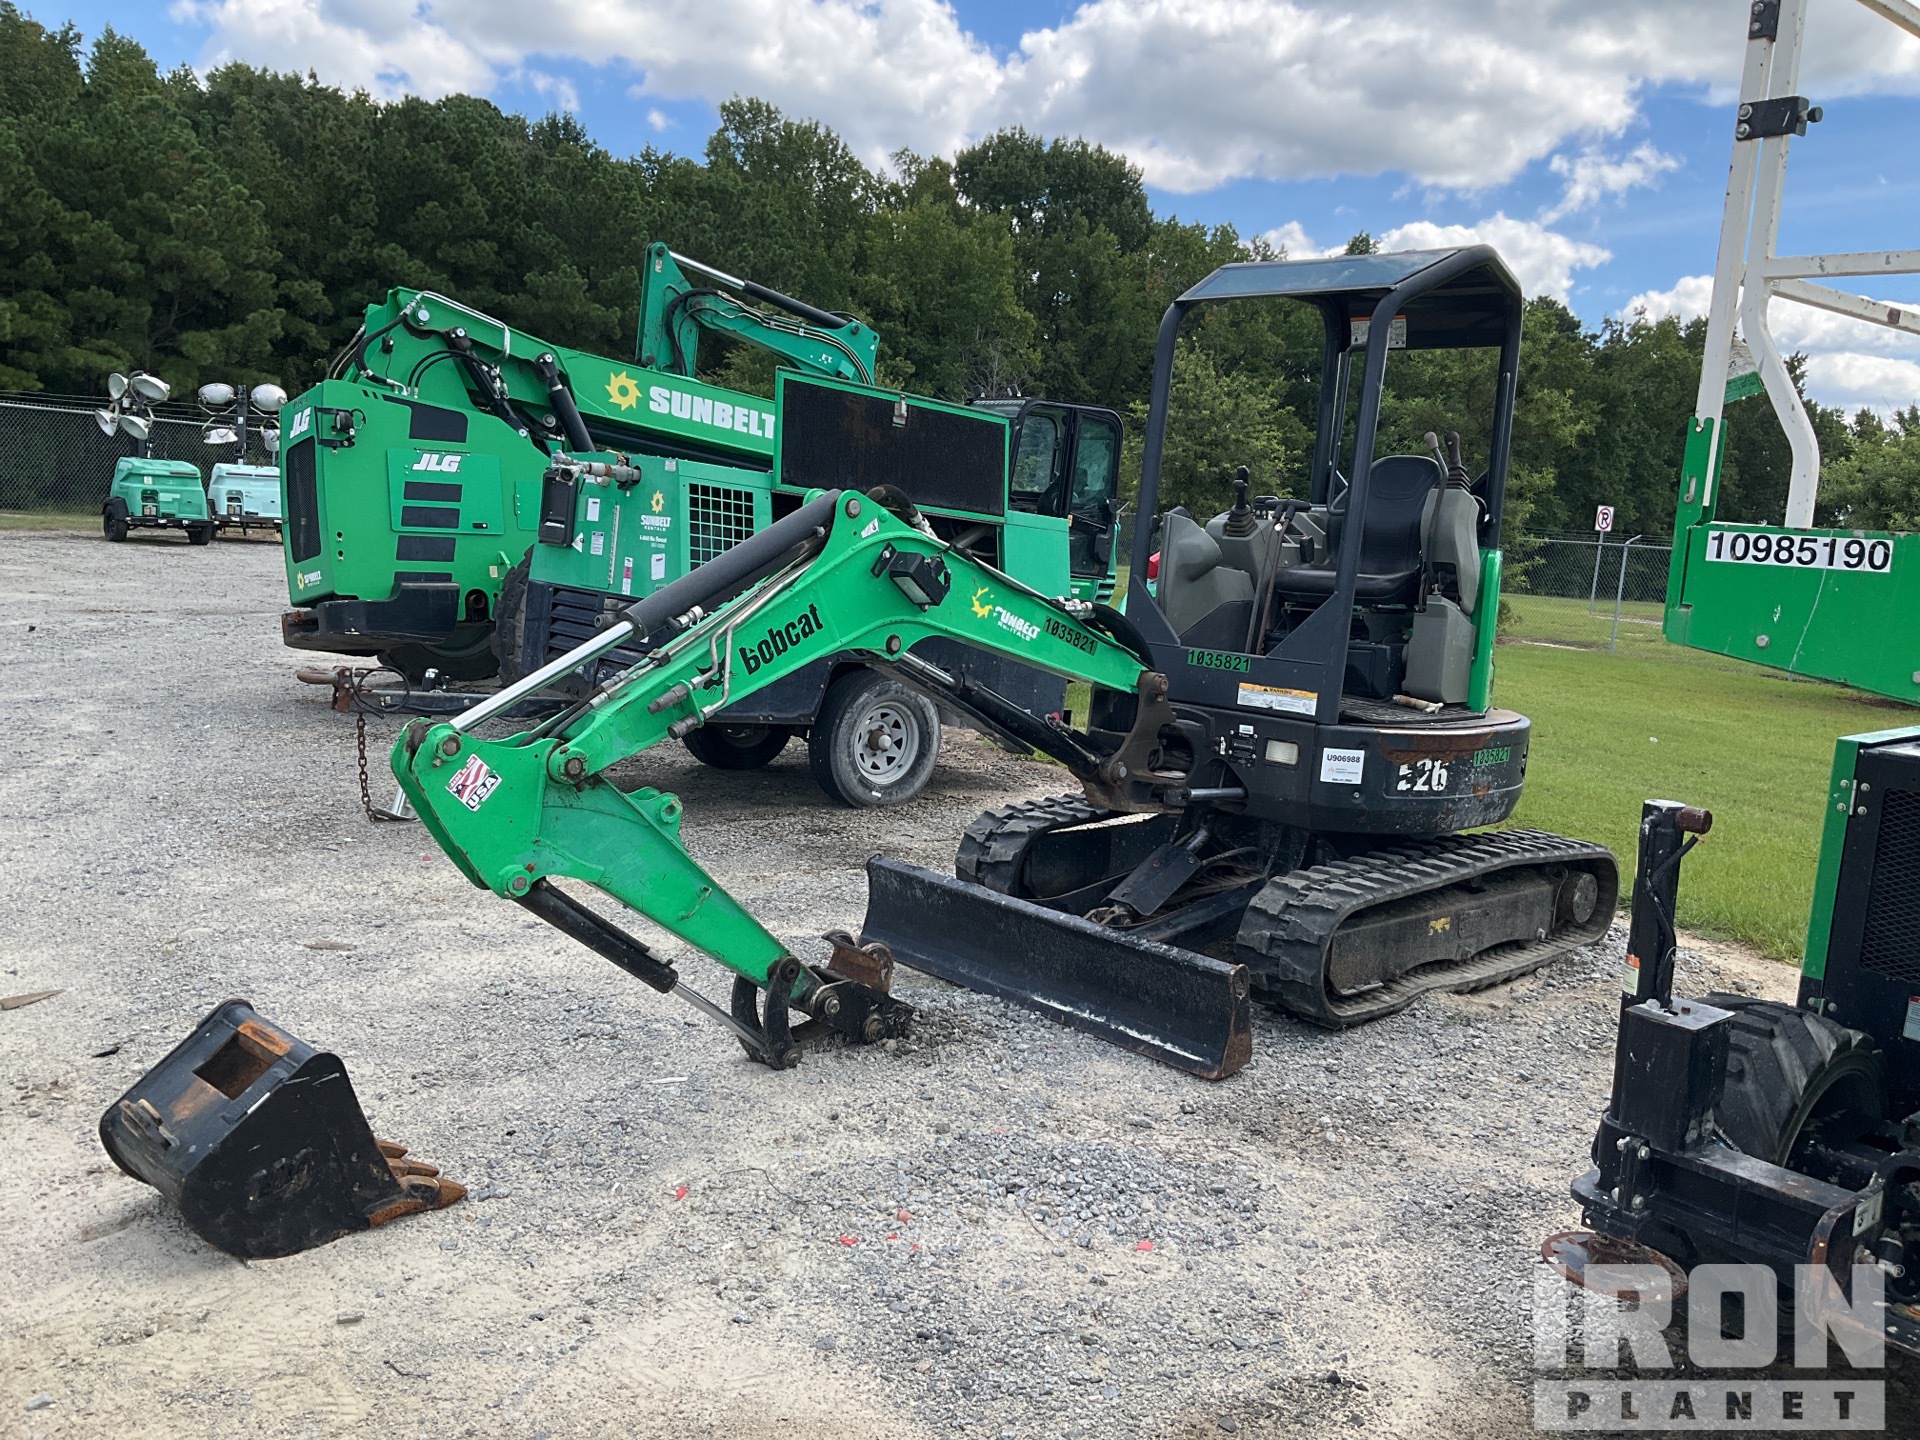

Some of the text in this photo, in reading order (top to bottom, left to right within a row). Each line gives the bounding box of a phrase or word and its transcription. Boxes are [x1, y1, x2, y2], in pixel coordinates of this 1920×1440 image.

[289, 406, 311, 439] JLG
[650, 386, 775, 439] SUNBELT
[411, 453, 461, 473] JLG
[1711, 531, 1890, 571] 10985190
[1045, 616, 1095, 655] 1035821
[1189, 649, 1250, 671] 1035821
[1327, 754, 1360, 763] U906988
[466, 774, 498, 808] USA
